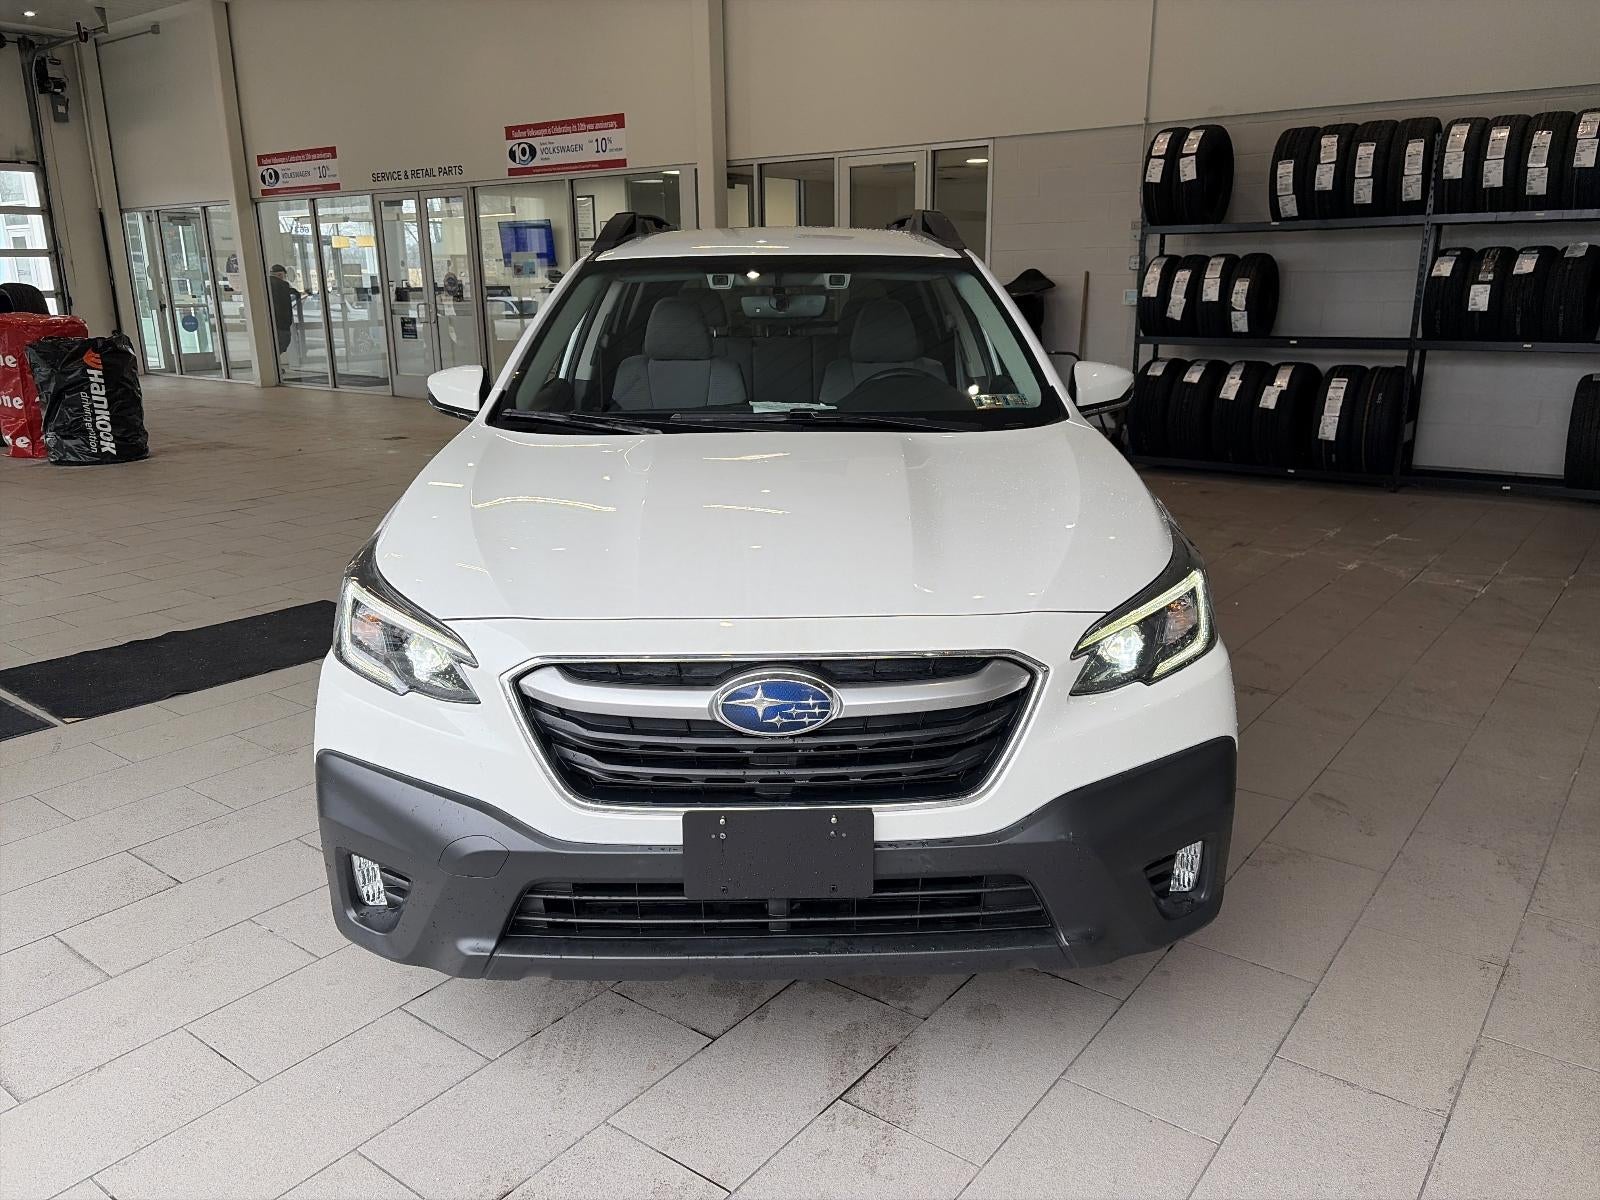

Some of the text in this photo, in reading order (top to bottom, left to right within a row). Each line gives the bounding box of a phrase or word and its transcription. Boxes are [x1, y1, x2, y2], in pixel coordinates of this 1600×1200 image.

[540, 144, 584, 156] VOLKSWAGEN
[371, 164, 464, 183] SERVICE & RETAIL PARTS
